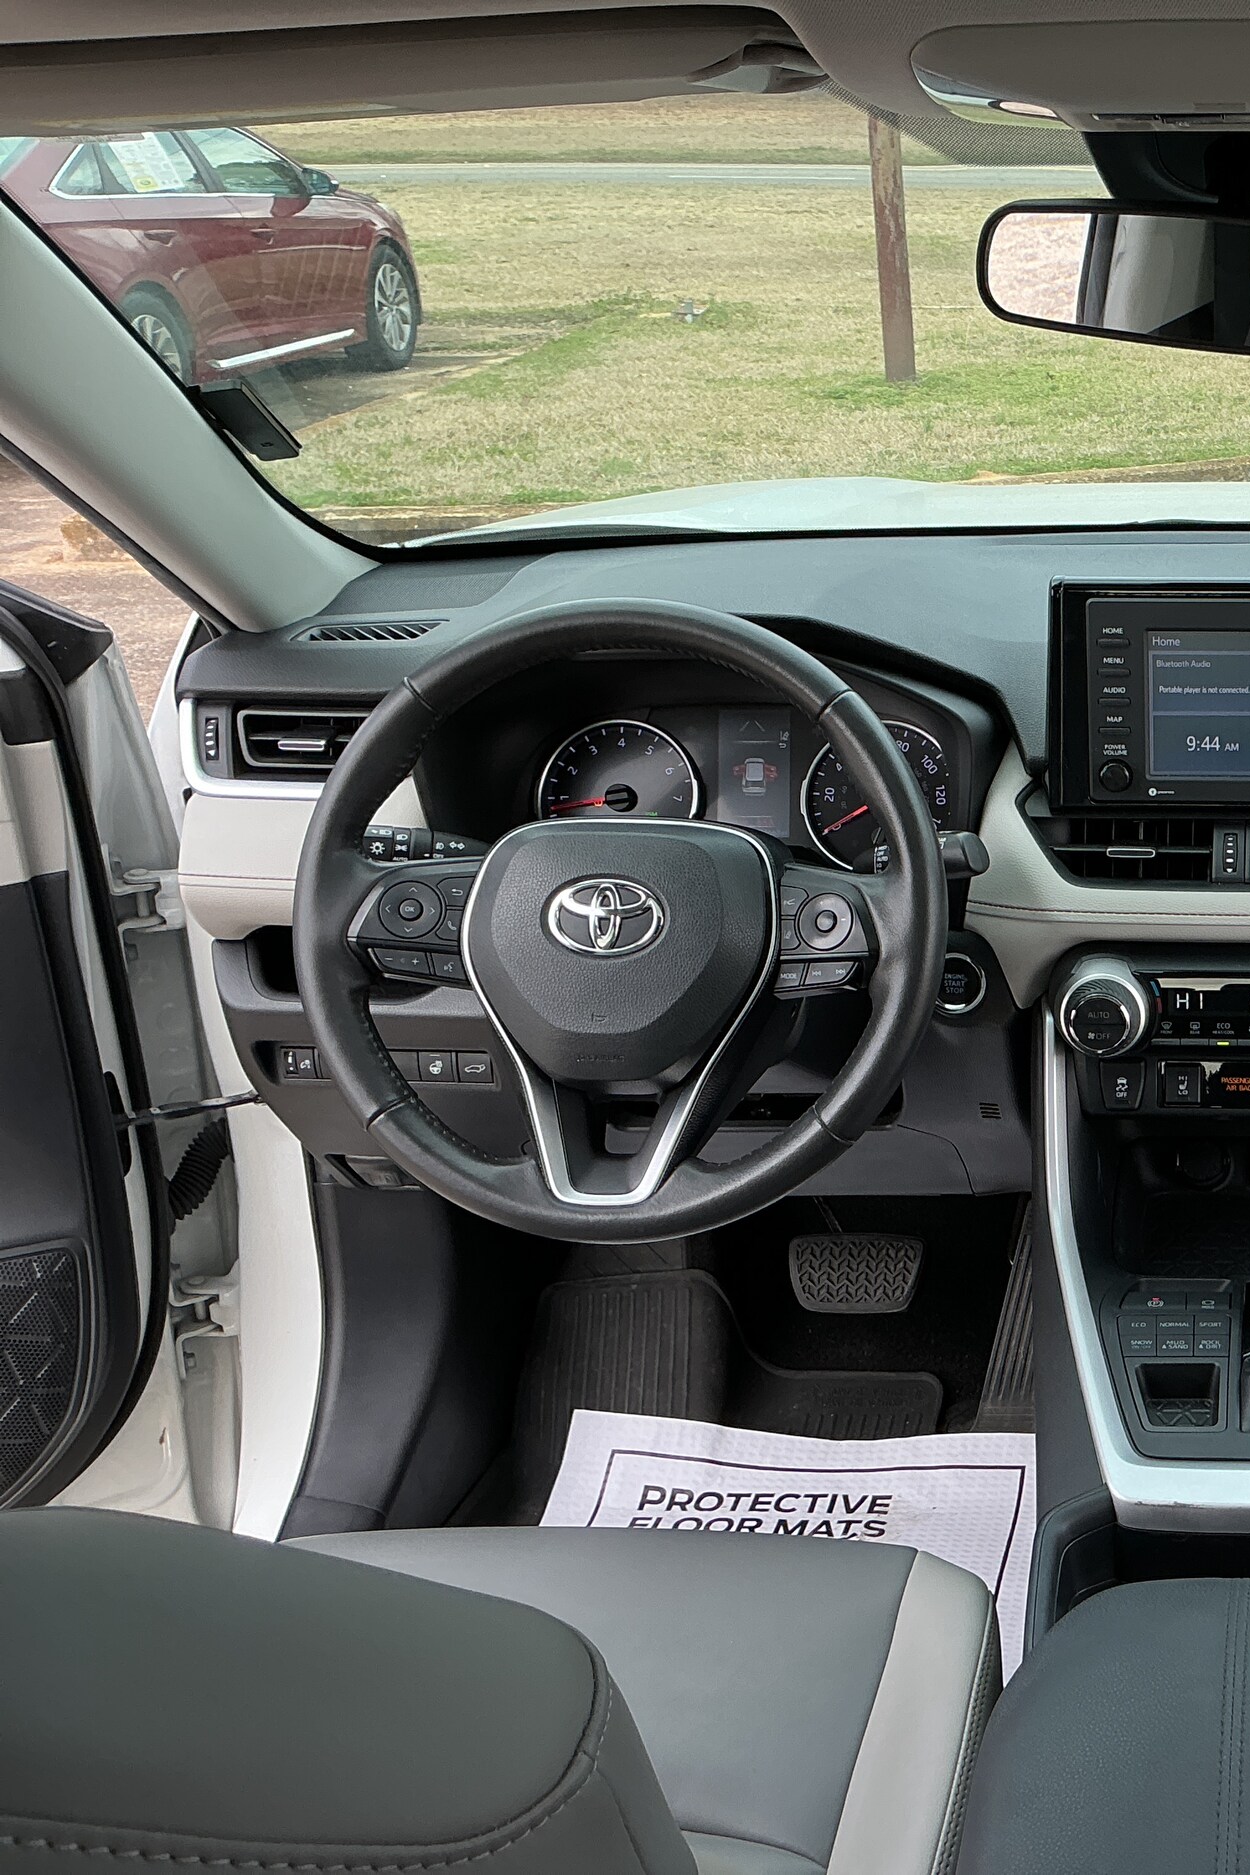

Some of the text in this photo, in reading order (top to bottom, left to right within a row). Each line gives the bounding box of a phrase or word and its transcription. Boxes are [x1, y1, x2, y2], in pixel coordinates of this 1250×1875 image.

[1102, 627, 1124, 635] HOME
[1152, 636, 1181, 647] Home
[1156, 659, 1211, 668] Bluetooth Audio
[1102, 686, 1126, 694] AUDIO
[1158, 685, 1250, 695] Portable player is not connected.
[617, 738, 626, 748] 4
[1186, 735, 1240, 752] 9:44 AM
[588, 744, 598, 756] 3
[644, 745, 655, 756] 5
[920, 754, 938, 775] 100
[567, 765, 578, 776] 2
[665, 766, 675, 776] 6
[672, 794, 683, 802] 7
[824, 787, 835, 803] 20
[935, 784, 947, 805] 120
[780, 971, 798, 981] MODE
[1087, 1010, 1110, 1019] AUTO
[1216, 1022, 1231, 1030] ECO
[1095, 1032, 1111, 1041] OFF
[1225, 1084, 1238, 1092] AIR
[637, 1484, 893, 1516] PROTECTIVE
[772, 1518, 887, 1540] MATS
